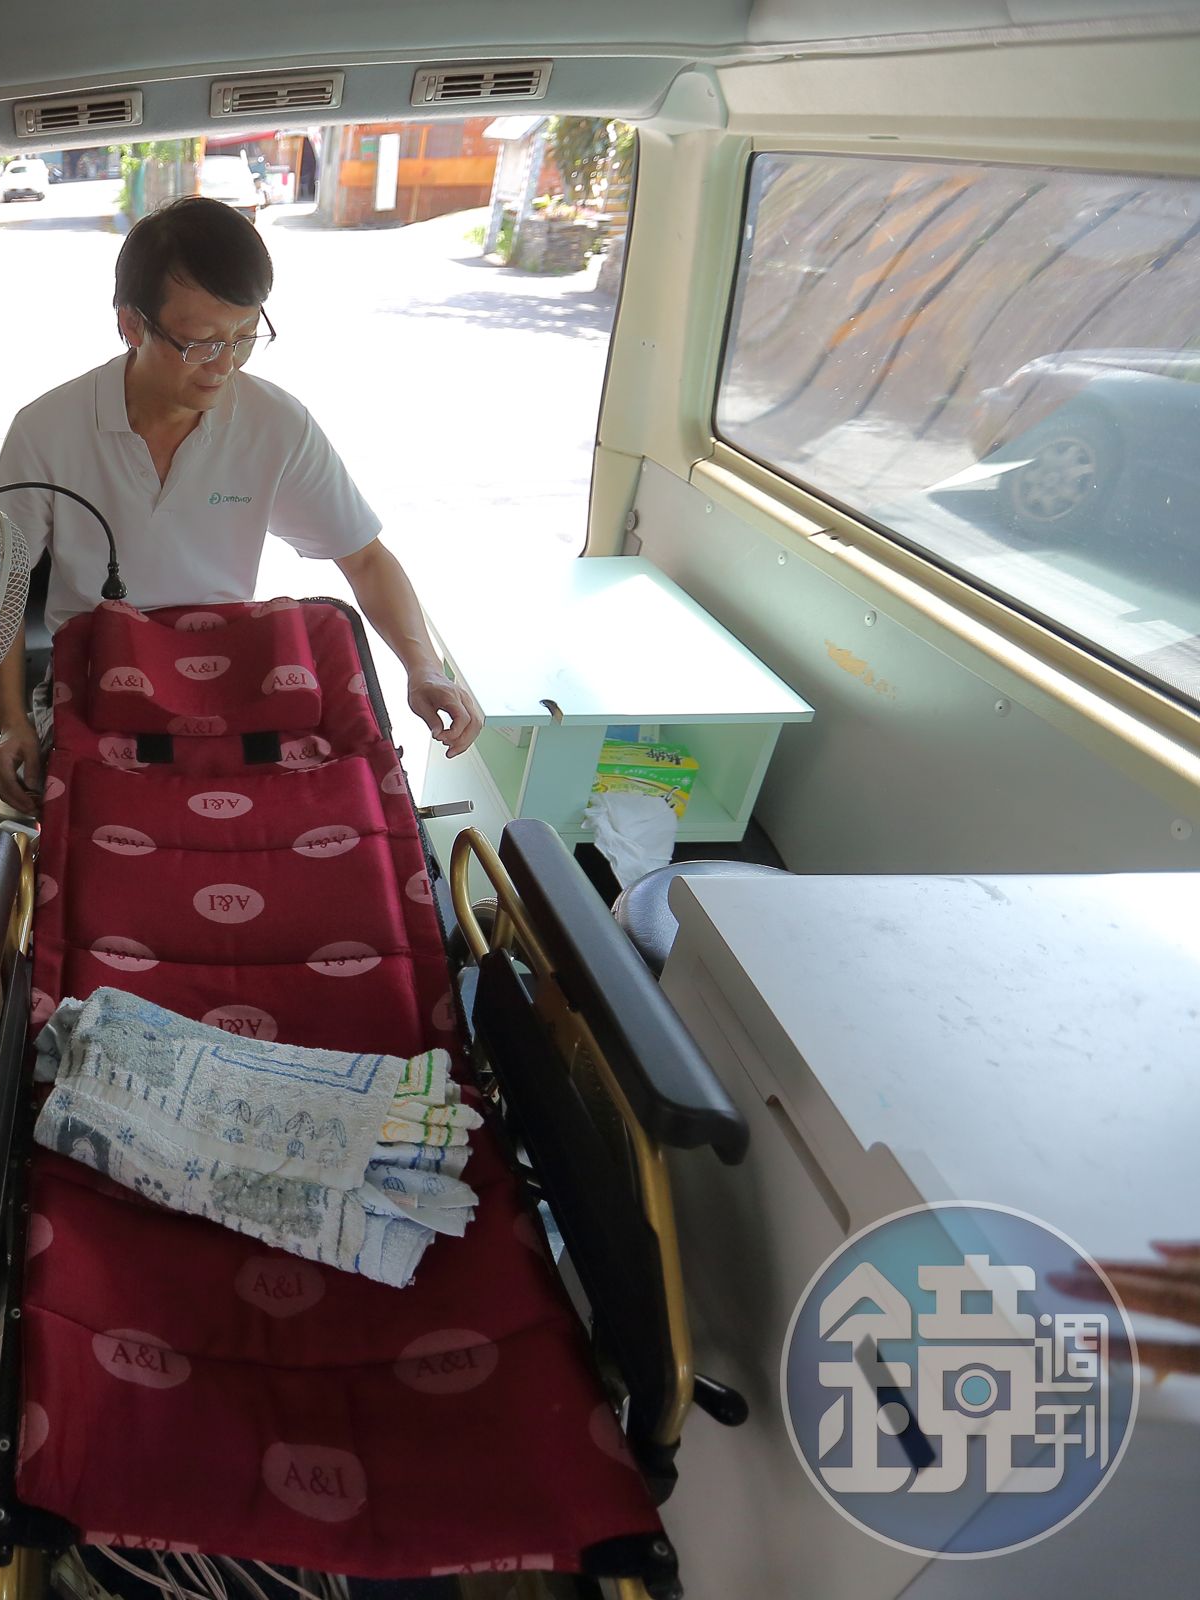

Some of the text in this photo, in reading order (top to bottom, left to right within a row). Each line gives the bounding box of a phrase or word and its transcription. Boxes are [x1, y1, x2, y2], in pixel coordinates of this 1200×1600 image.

[185, 661, 218, 675] A&I
[110, 674, 145, 688] A&I
[272, 672, 307, 689] A&I
[183, 721, 214, 735] A&I
[285, 744, 320, 762] A&I
[201, 797, 241, 812] A&I
[208, 894, 250, 912] A&I
[253, 1270, 307, 1299] A&I
[111, 1343, 171, 1375] A&I
[283, 1460, 348, 1499] A&I
